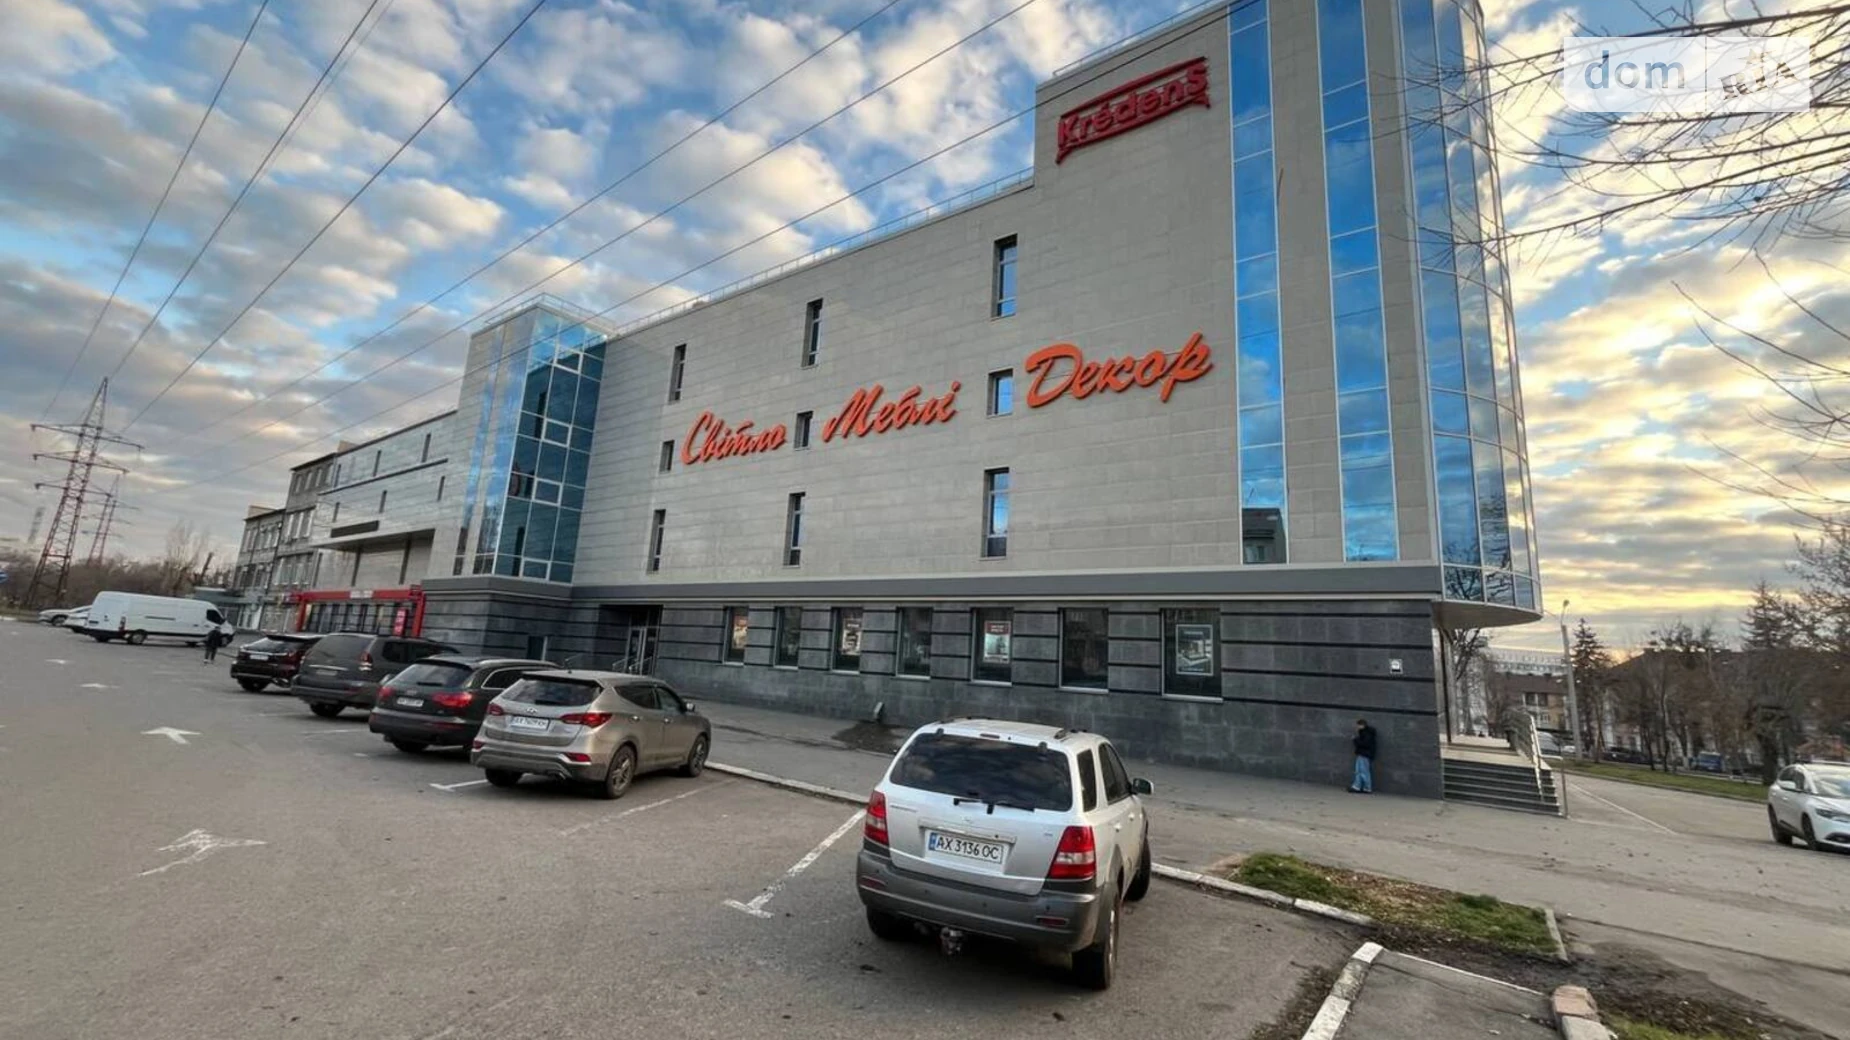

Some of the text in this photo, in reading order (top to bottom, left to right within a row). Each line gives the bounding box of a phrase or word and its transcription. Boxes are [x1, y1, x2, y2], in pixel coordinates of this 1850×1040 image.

[681, 332, 1214, 465] Світло Меблі Декор
[936, 836, 999, 860] AX 3136 OC
